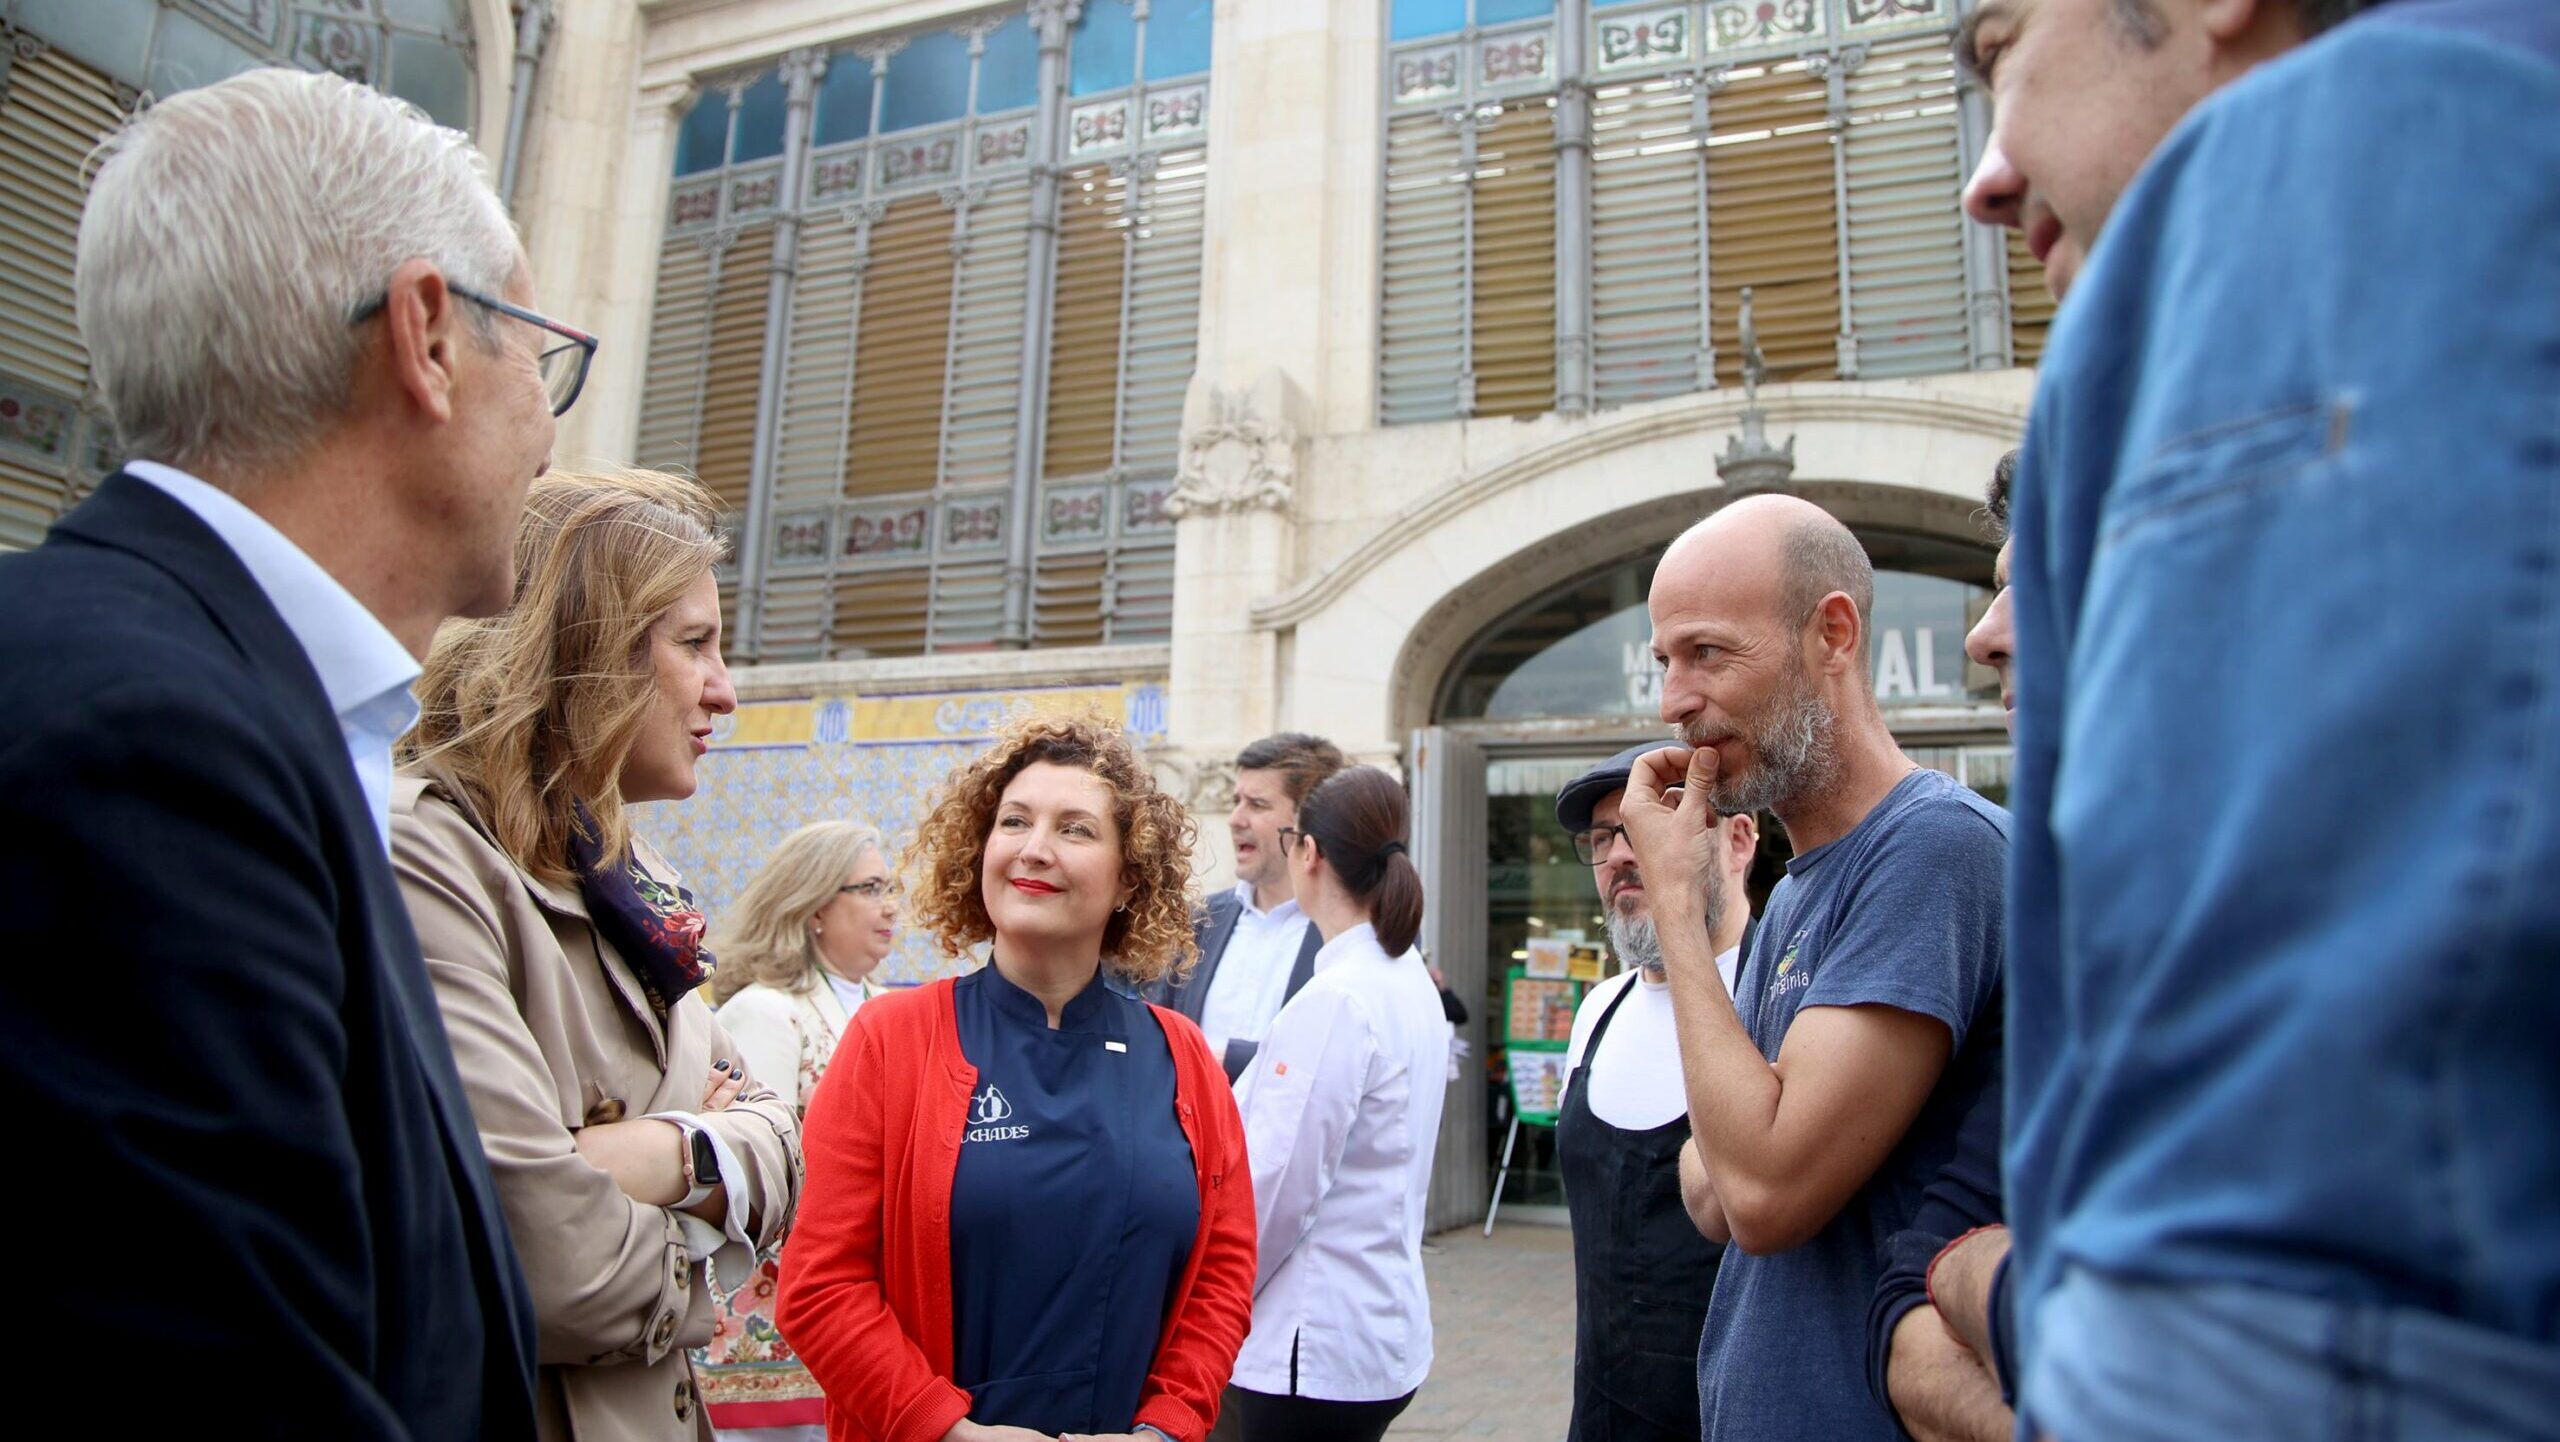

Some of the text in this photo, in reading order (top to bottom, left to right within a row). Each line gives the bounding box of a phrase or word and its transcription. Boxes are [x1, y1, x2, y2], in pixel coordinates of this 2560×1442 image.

[1874, 626, 1951, 698] AL
[1630, 674, 1663, 706] CA
[961, 1125, 1029, 1143] UCHADES
